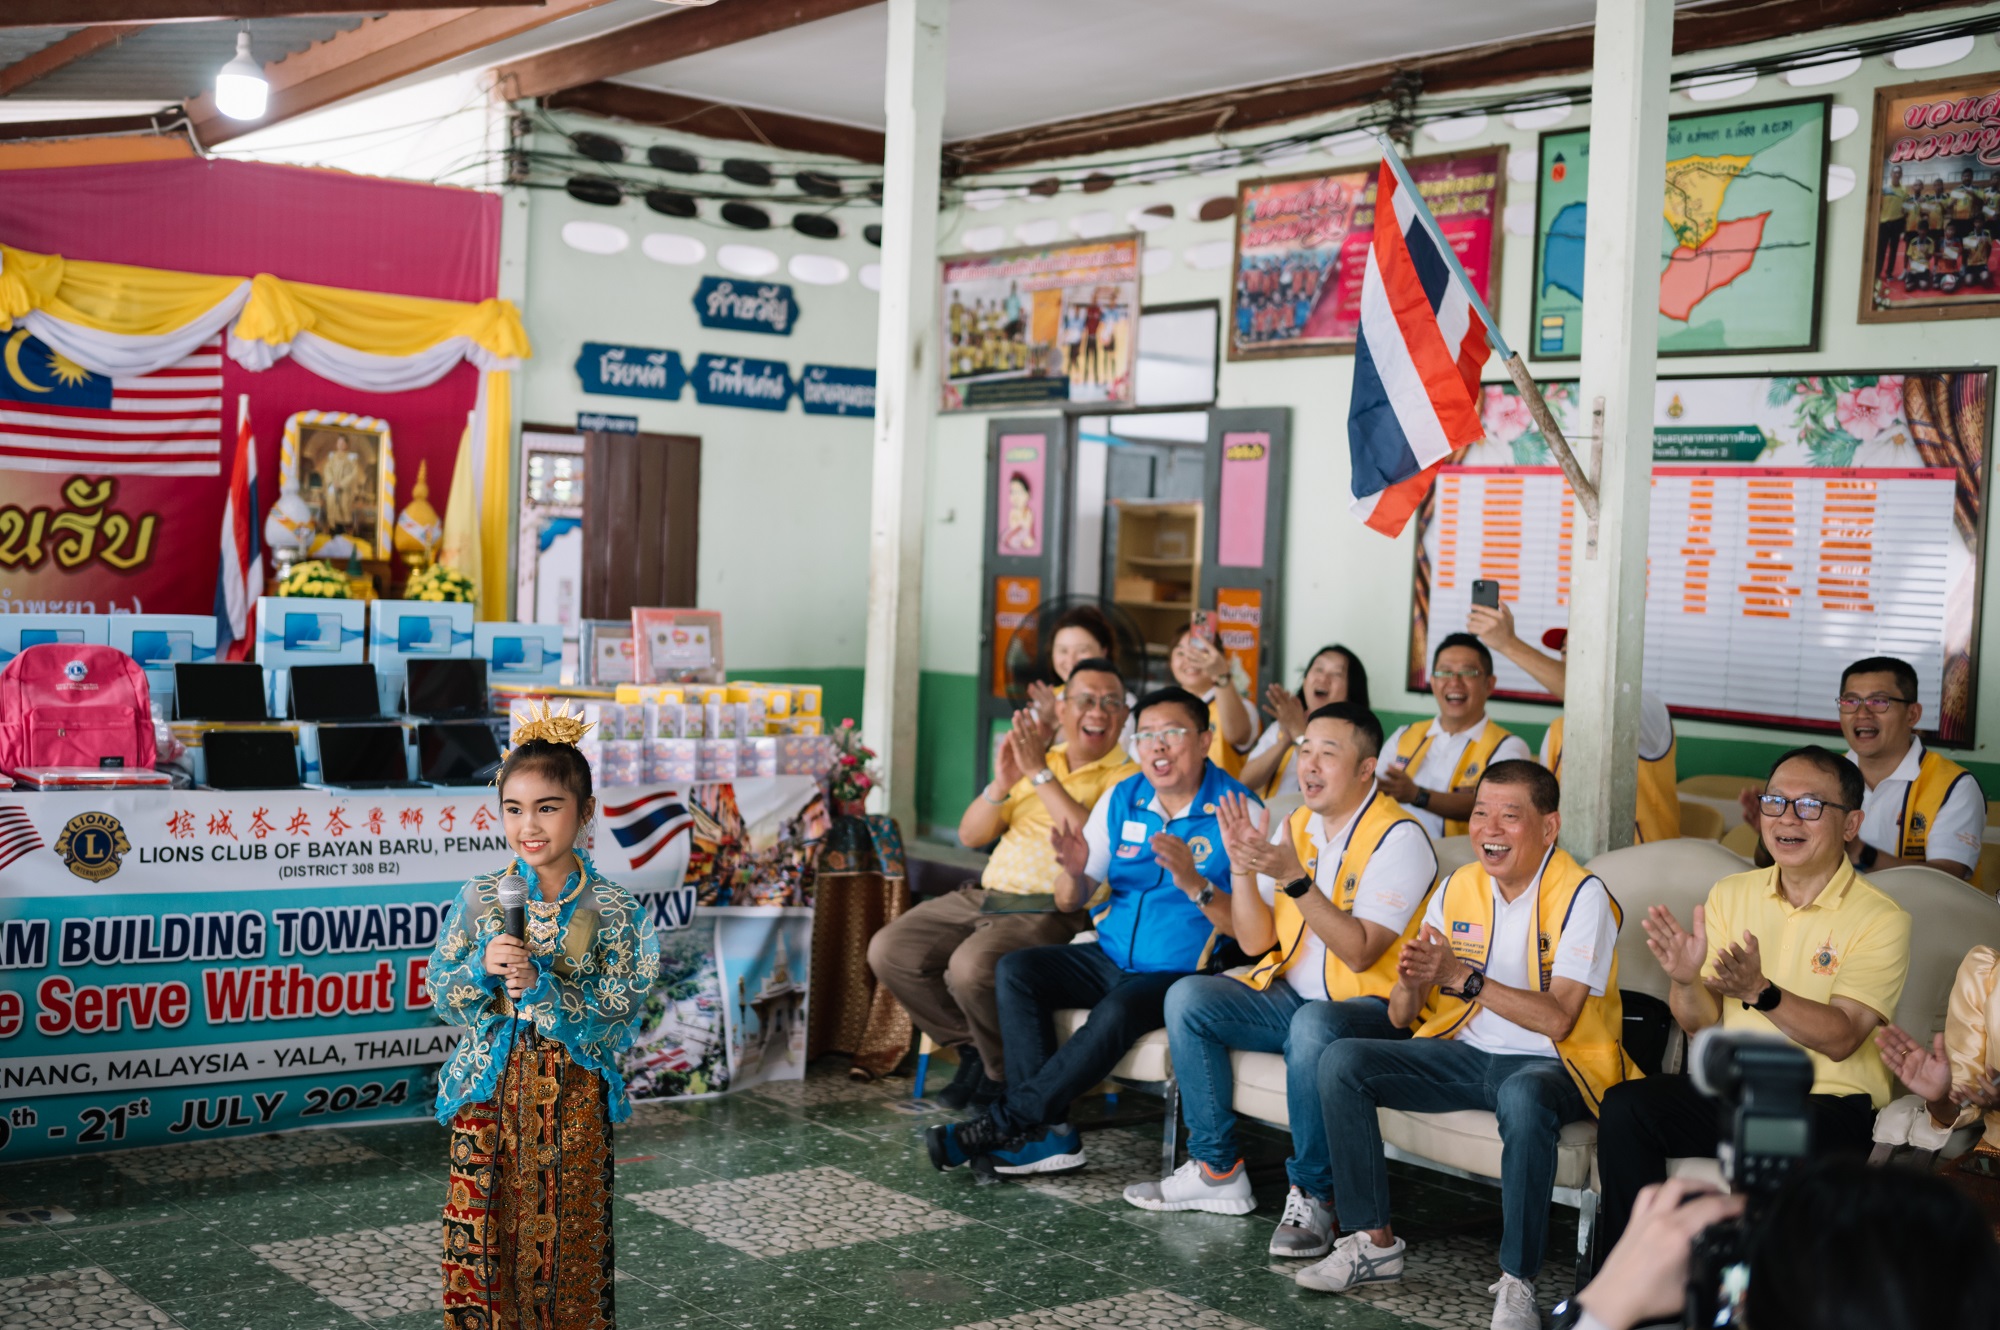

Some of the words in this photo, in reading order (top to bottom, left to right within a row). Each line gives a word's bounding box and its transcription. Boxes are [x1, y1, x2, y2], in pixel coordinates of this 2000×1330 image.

[72, 815, 116, 830] LIONS
[139, 846, 204, 864] LIONS
[211, 844, 268, 862] CLUB
[274, 842, 301, 860] OF
[308, 840, 373, 858] BAYAN
[379, 838, 438, 856] BARU,
[73, 864, 115, 876] INTERNATIONAL
[279, 864, 348, 880] (DISTRICT
[352, 863, 375, 876] 308
[378, 861, 401, 877] B2)
[0, 922, 46, 966] M
[61, 912, 264, 965] BUILDING
[38, 978, 188, 1032] Serve
[204, 962, 393, 1022] Without
[0, 1063, 97, 1089] NANG,
[107, 1053, 249, 1081] MALAYSIA
[273, 1044, 346, 1067] YALA,
[170, 1092, 286, 1133] JULY
[302, 1081, 409, 1117] 2024
